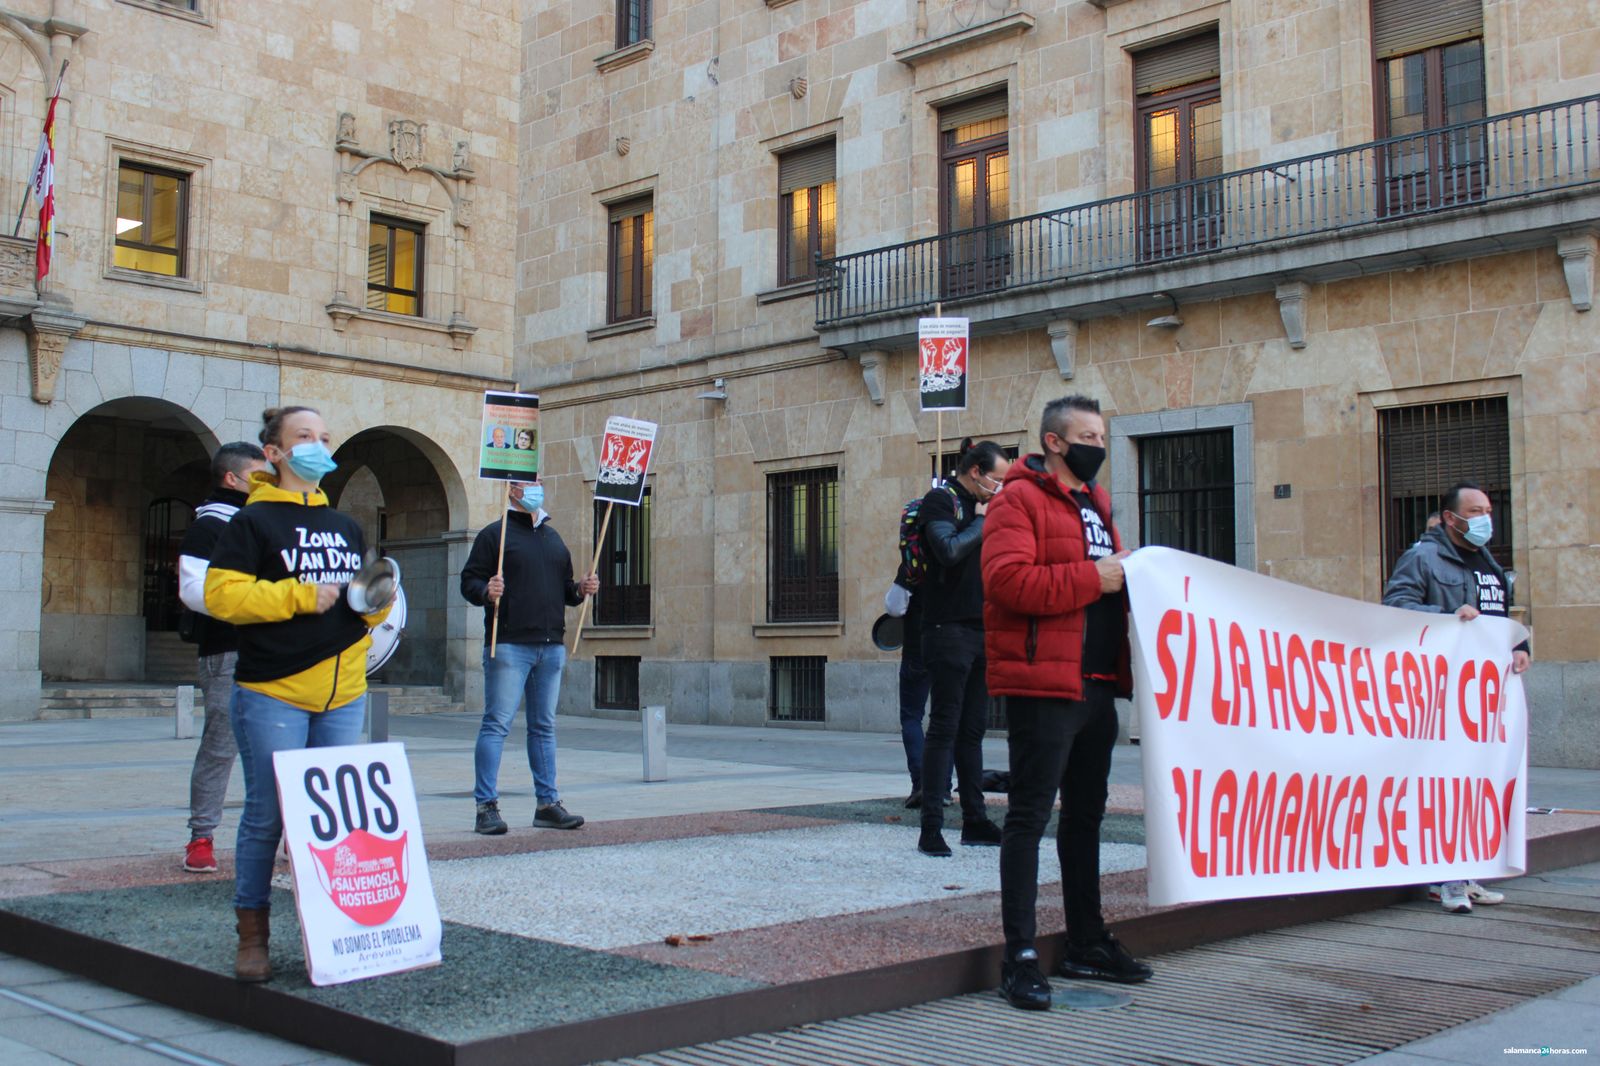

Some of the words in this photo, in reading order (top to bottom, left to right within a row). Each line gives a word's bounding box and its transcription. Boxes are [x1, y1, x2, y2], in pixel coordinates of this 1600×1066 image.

[1081, 508, 1104, 527] ONA
[295, 527, 348, 548] ZONA
[280, 548, 325, 572] VAN
[326, 547, 361, 570] DYC
[299, 571, 355, 585] SALAMANC
[1474, 571, 1501, 585] ZONA
[1208, 617, 1256, 728] LA
[1258, 625, 1449, 742] HOSTELERÍA
[304, 761, 399, 842] SOS
[1171, 767, 1368, 878] ALAMANCA
[1373, 776, 1409, 868] SE
[332, 938, 344, 956] NO
[344, 933, 372, 954] SOMOS
[371, 931, 382, 948] EL
[382, 924, 423, 947] PROBLEMA
